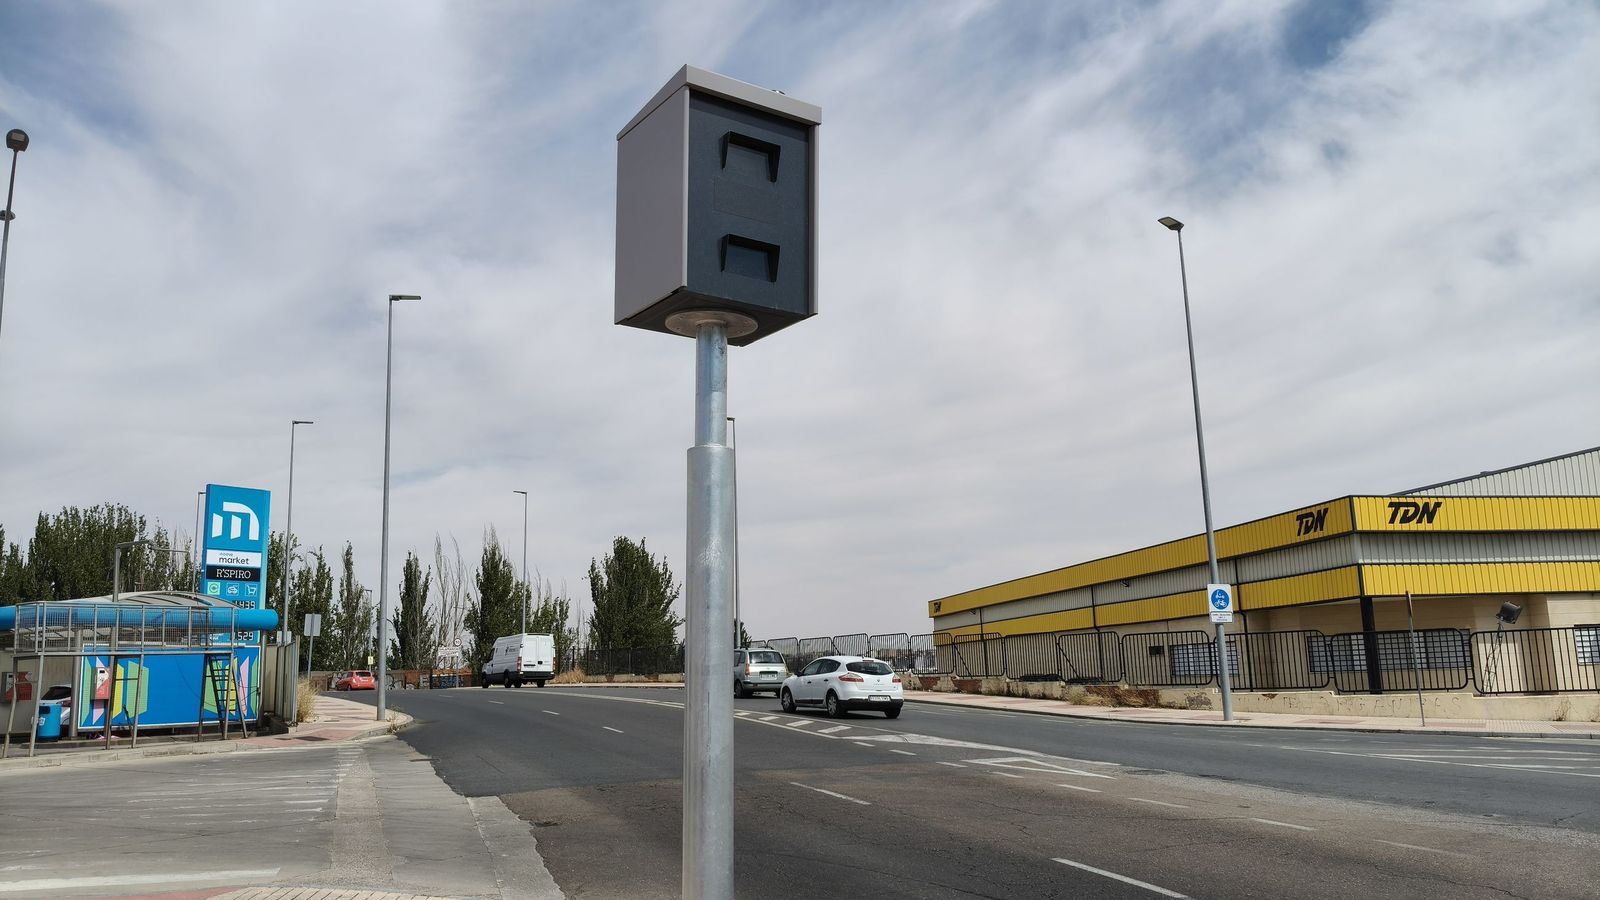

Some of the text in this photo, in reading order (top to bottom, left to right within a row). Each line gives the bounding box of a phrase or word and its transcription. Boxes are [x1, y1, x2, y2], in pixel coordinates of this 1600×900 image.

[1387, 501, 1442, 524] TDN
[1295, 507, 1329, 537] TDN
[218, 556, 249, 564] market
[216, 568, 252, 579] R'SPIRO
